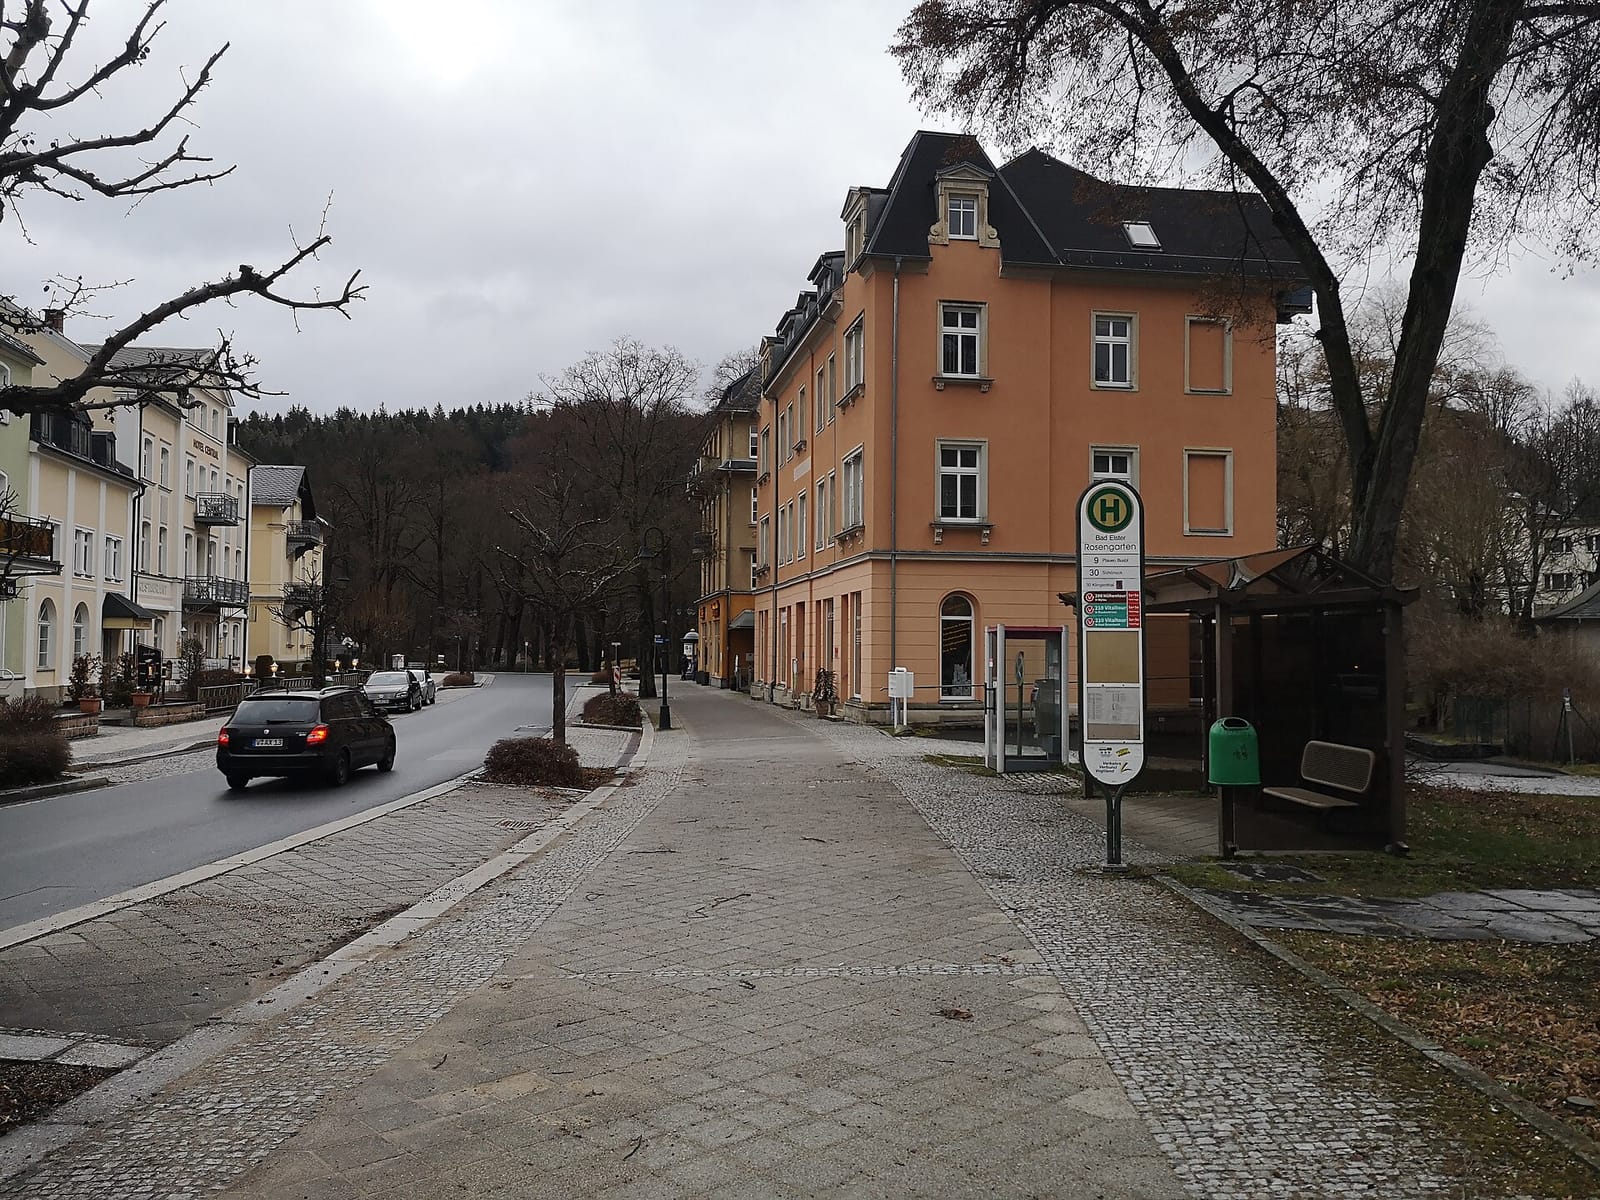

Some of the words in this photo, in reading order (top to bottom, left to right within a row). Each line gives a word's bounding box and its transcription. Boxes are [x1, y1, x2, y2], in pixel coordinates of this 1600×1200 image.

[193, 439, 204, 453] HOTEL
[1100, 498, 1120, 522] H
[1084, 543, 1137, 553] Rosengarten
[1093, 556, 1099, 564] 9
[1089, 568, 1100, 577] 30
